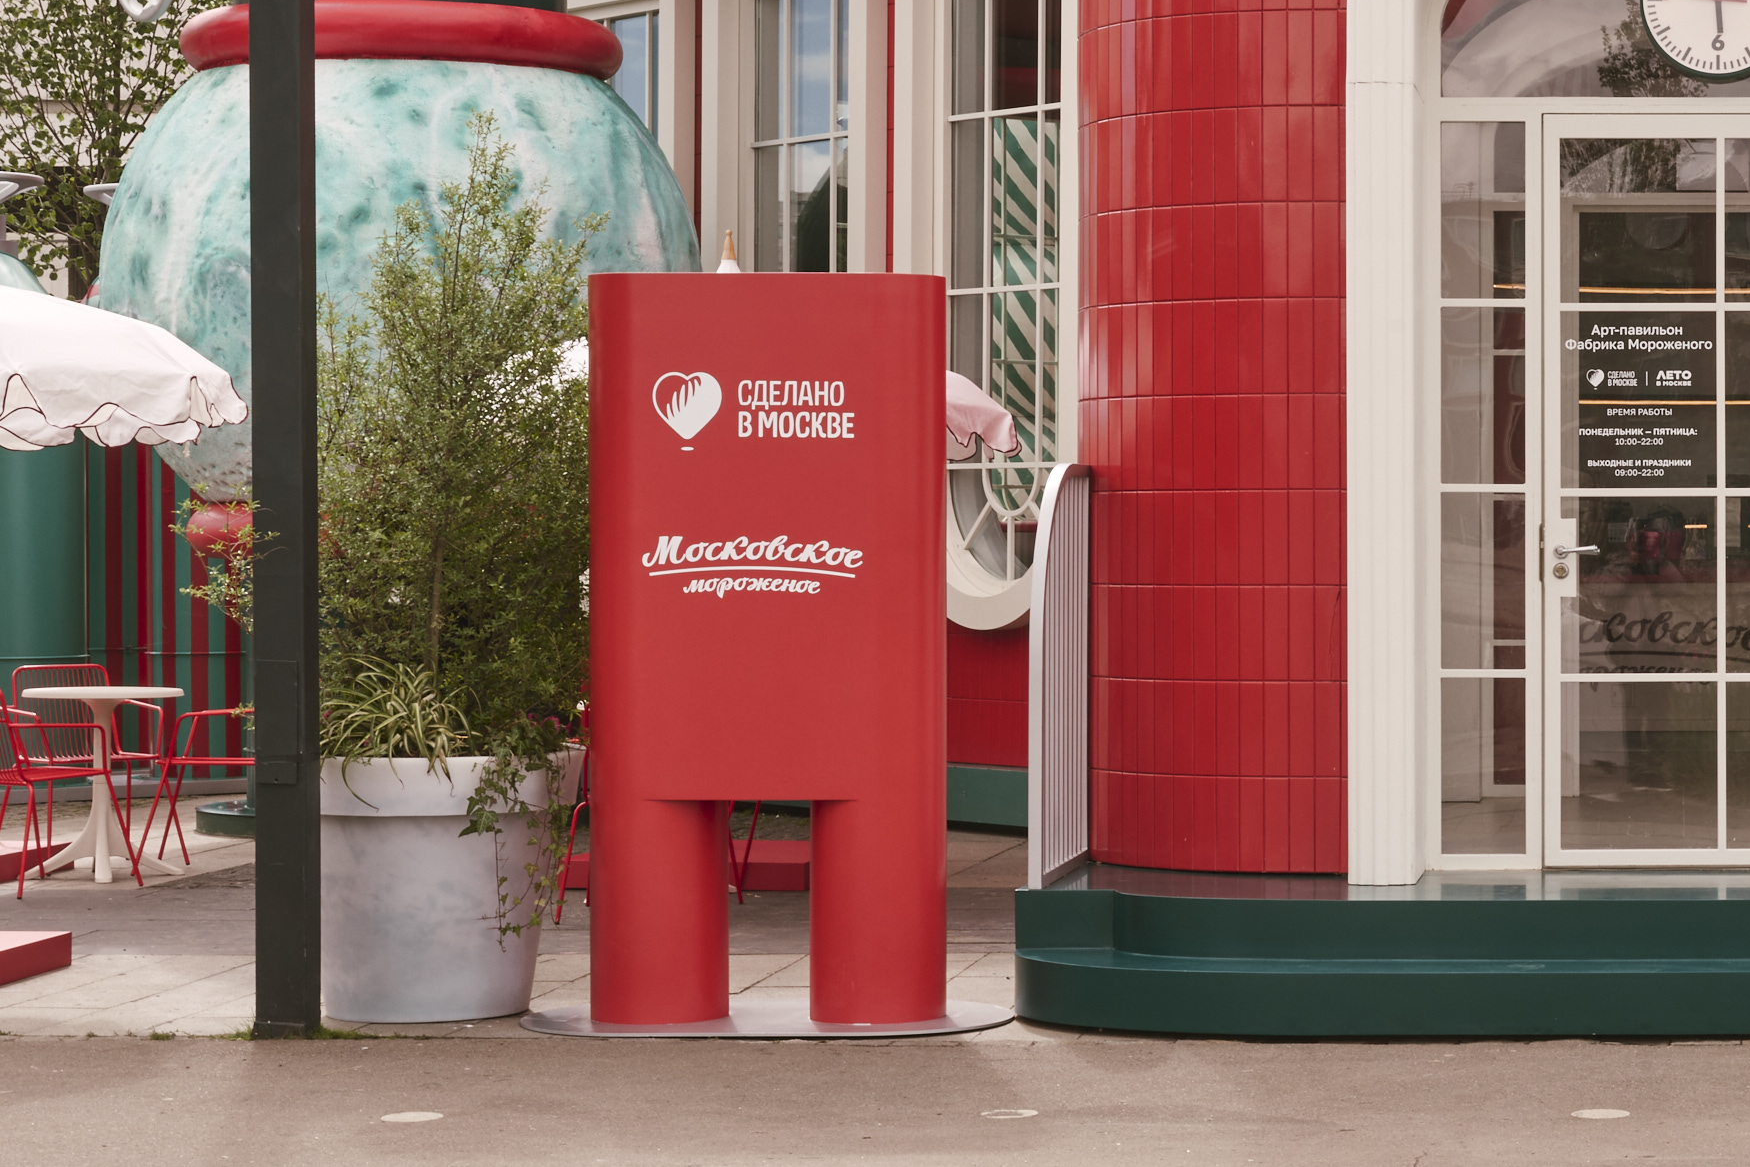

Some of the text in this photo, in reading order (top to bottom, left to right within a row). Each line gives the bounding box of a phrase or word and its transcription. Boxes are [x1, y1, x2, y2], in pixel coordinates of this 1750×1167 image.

[1711, 34, 1725, 52] 6
[1591, 324, 1683, 338] Арт-павильон
[1565, 339, 1713, 352] Фабрика Мороженого
[1607, 370, 1635, 379] СДЕЛАНО
[1656, 370, 1692, 380] ЛЕТО
[1607, 379, 1638, 387] В МОСКВЕ
[737, 379, 845, 410] СДЕЛАНО
[1606, 408, 1673, 416] ВРЕМЯ РАБОТЫ
[737, 411, 855, 439] В МОСКВЕ
[1579, 428, 1644, 436] ПОНЕДЕЛЬНИК
[1653, 428, 1698, 436] ПЯТНИЦА:
[1587, 459, 1692, 468] ВЫХОДНЫЕ И ПРАЗДНИКИ
[641, 535, 864, 569] Московское
[682, 577, 821, 599] мороженое
